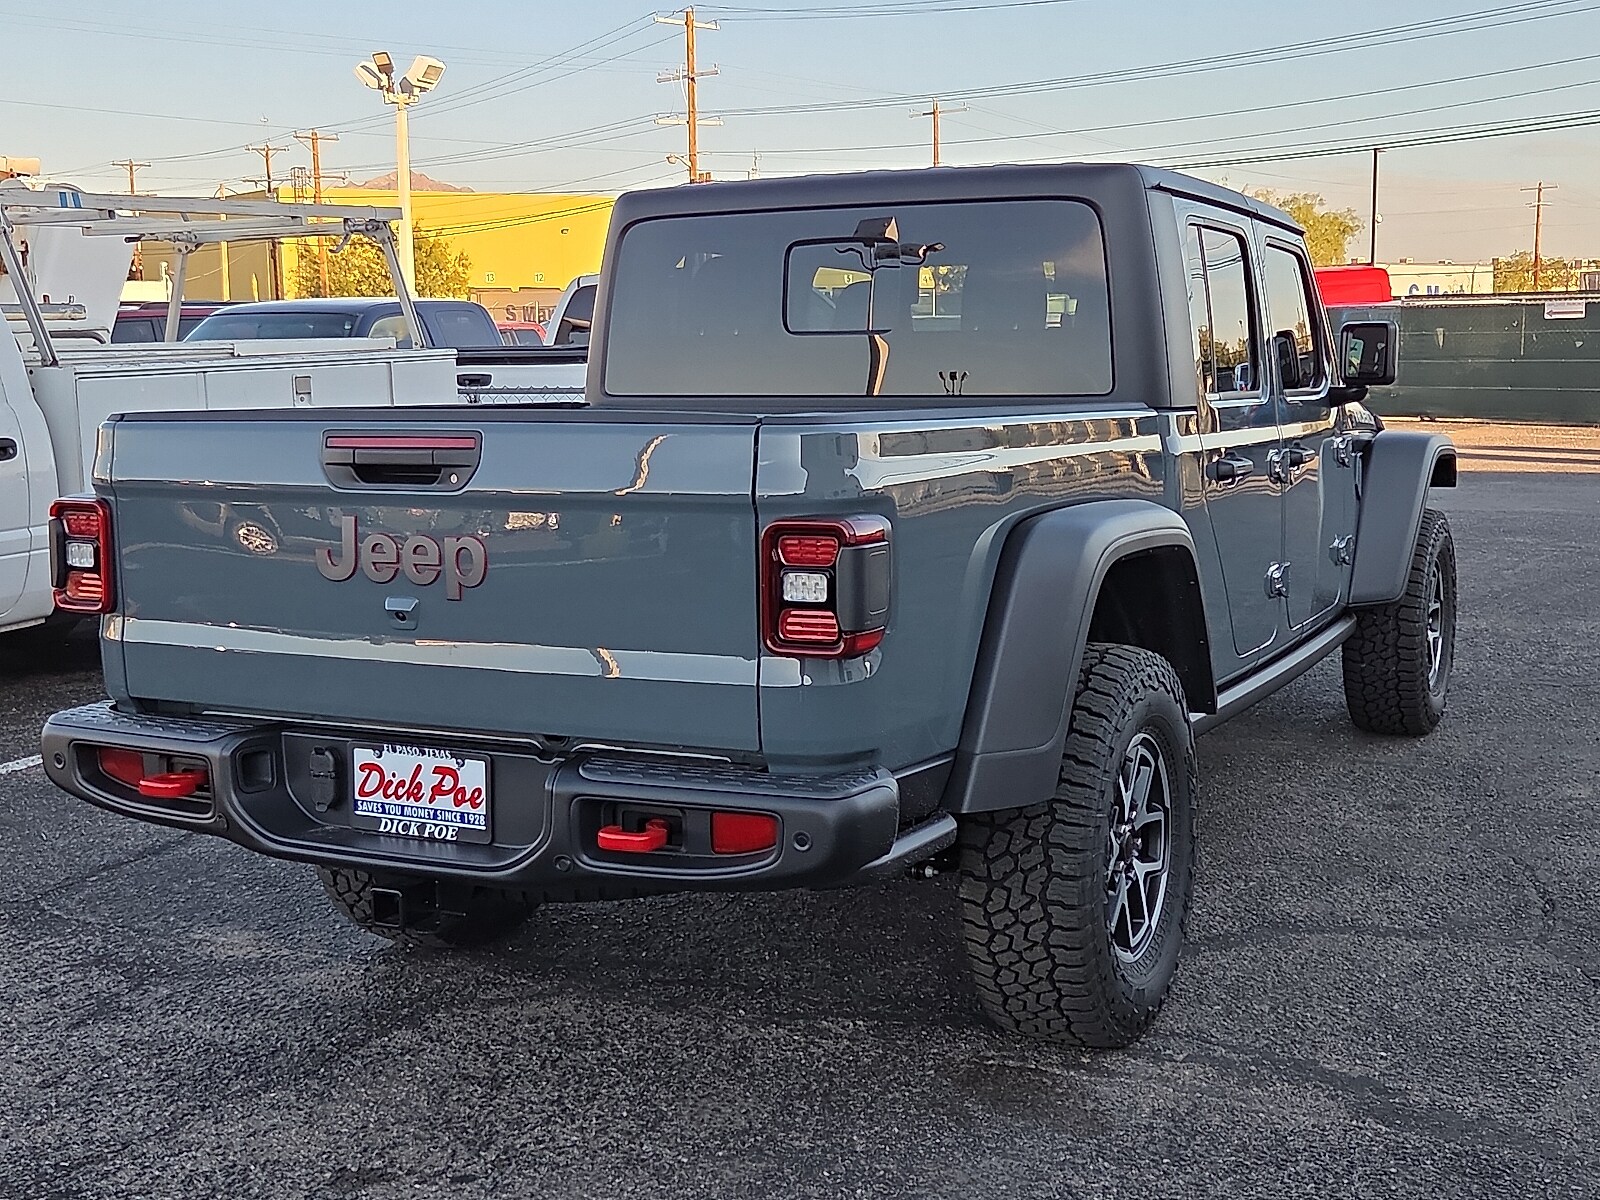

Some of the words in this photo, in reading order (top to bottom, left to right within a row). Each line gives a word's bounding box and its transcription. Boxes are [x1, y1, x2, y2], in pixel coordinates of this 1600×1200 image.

[486, 273, 494, 282] 13
[535, 273, 544, 282] 12
[316, 514, 487, 601] Jeep
[383, 744, 393, 754] EL
[425, 747, 452, 759] TEXAS
[358, 762, 425, 803] Dick
[428, 765, 485, 810] Poe
[357, 800, 382, 812] SAVES
[384, 803, 401, 815] YOU
[403, 806, 434, 820] MONEY
[437, 810, 461, 822] SINCE
[464, 813, 486, 826] 1928
[378, 818, 419, 836] DICK
[423, 823, 459, 841] POE
